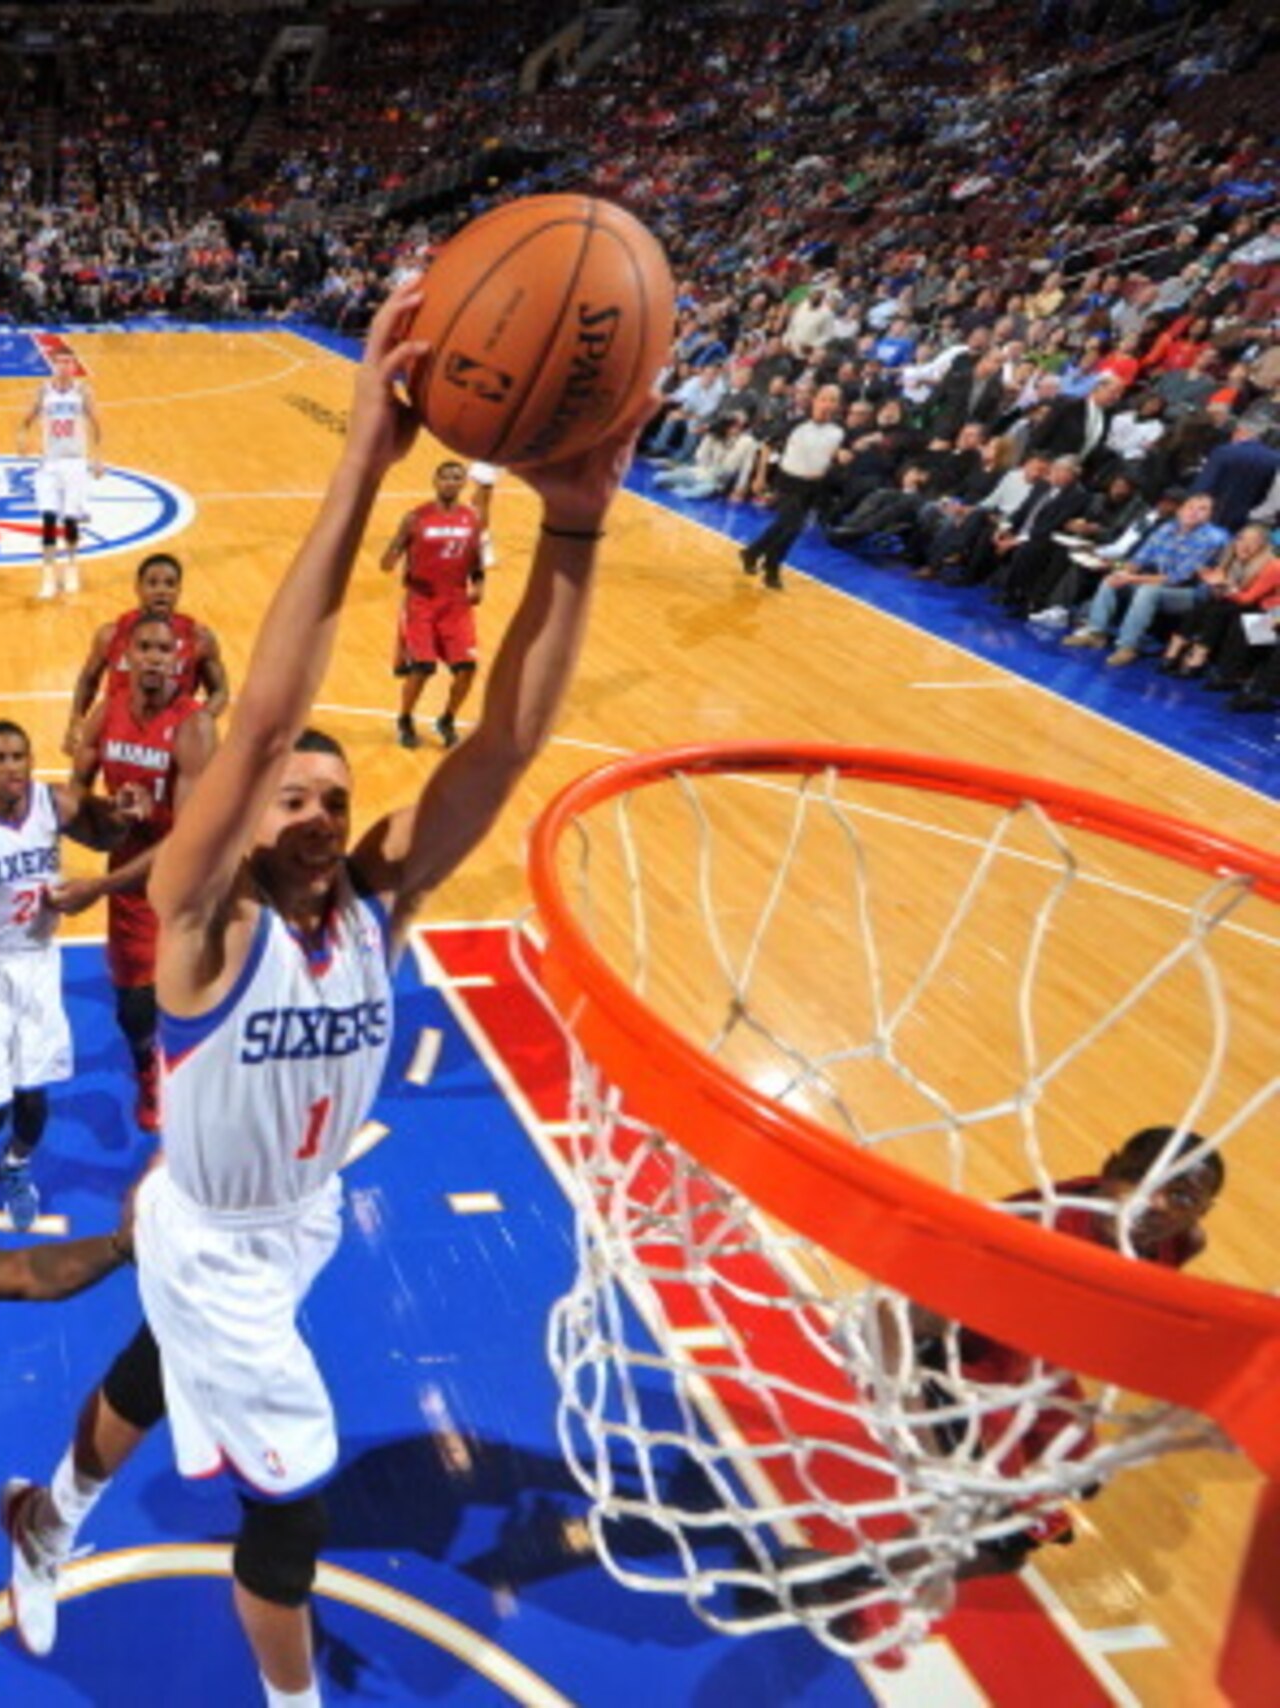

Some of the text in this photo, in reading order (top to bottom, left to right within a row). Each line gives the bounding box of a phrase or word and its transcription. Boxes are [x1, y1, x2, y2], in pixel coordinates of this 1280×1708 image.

[508, 303, 622, 460] SPAL
[105, 738, 170, 770] MIAMI
[241, 1001, 388, 1065] SIXERS
[296, 1095, 331, 1160] 1
